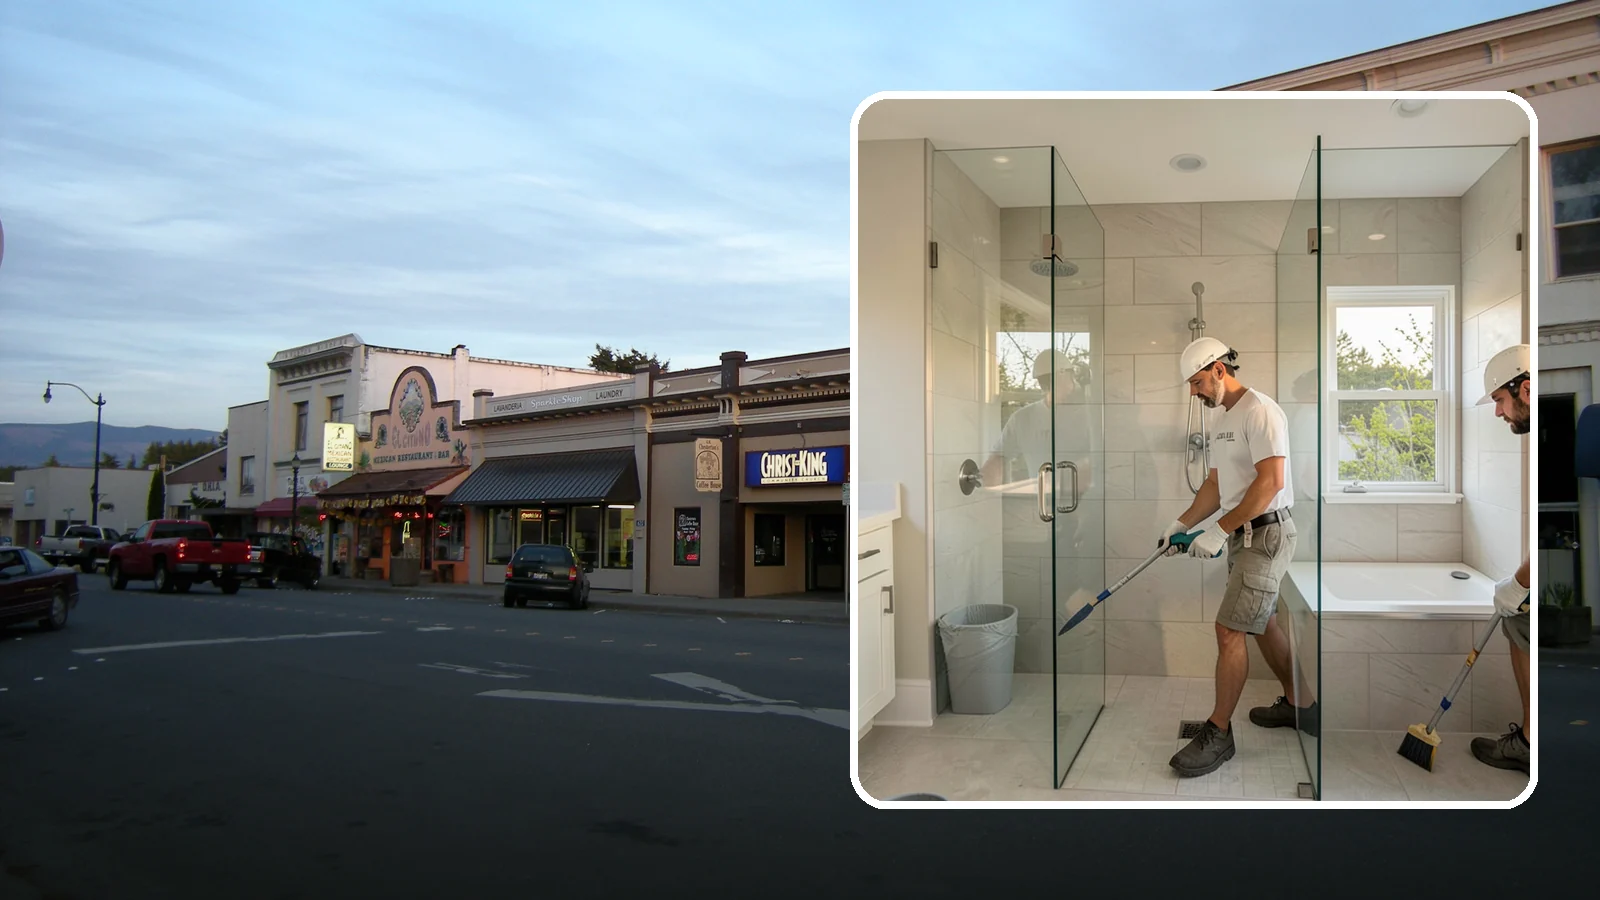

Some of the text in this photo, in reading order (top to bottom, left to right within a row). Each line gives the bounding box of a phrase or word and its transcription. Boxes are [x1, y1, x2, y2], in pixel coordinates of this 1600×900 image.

[530, 394, 582, 409] Sparkle Shop
[595, 389, 624, 400] LAUNDRY
[493, 402, 523, 412] LAVANDERIA
[391, 425, 401, 449] EL
[327, 439, 333, 450] EL
[374, 454, 396, 464] MEXICAN
[398, 451, 433, 462] RESTAURANT
[438, 450, 449, 459] BAR
[761, 450, 827, 477] CHRIST KING
